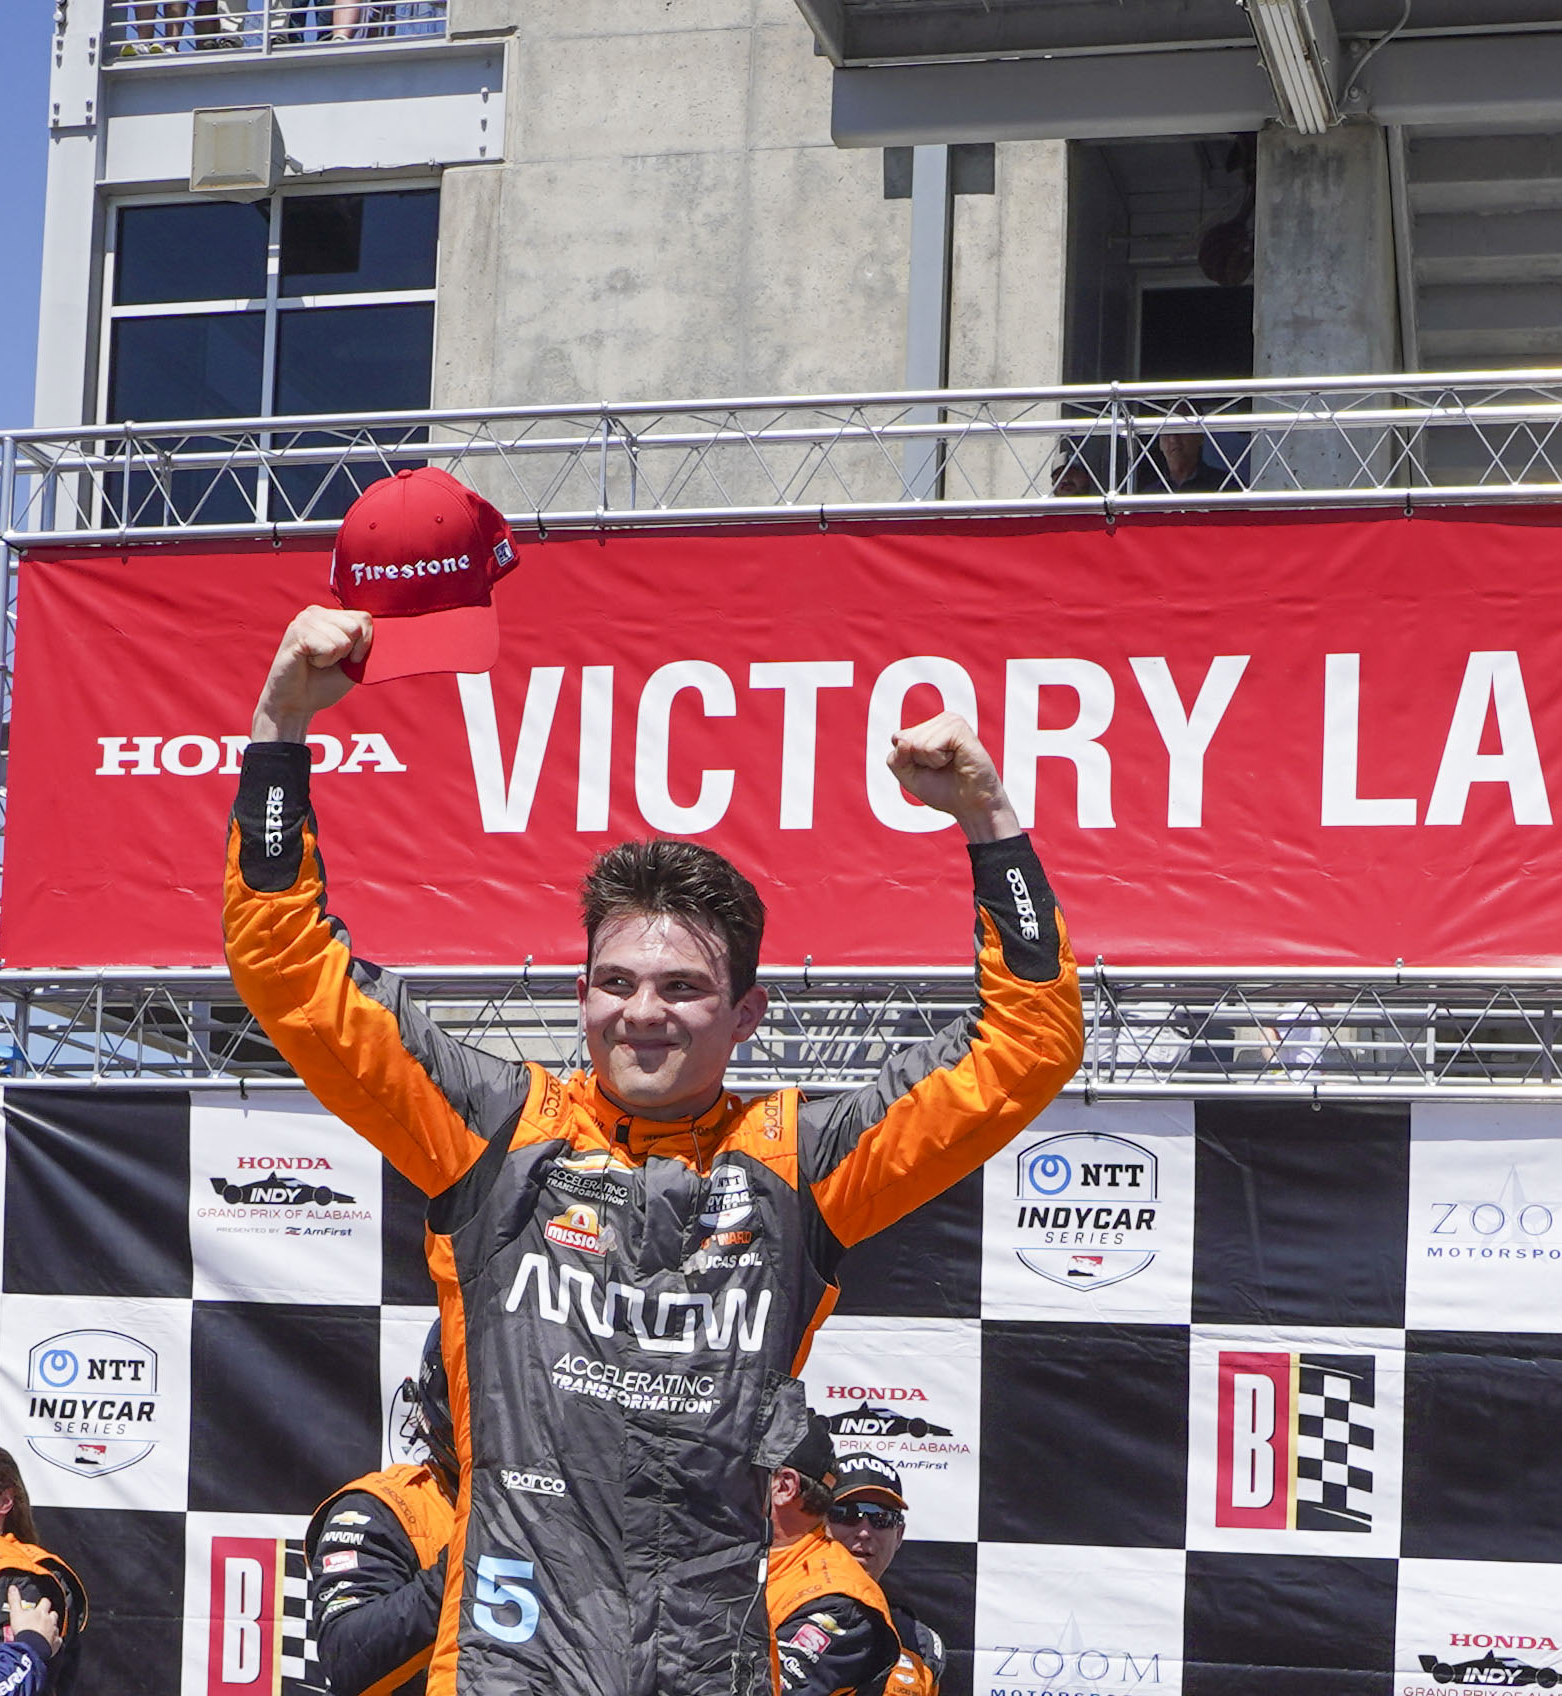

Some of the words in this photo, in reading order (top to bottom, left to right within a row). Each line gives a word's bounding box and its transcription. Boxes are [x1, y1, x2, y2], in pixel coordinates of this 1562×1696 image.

[350, 553, 470, 586] Firestone
[457, 655, 1250, 834] VICTORY
[266, 784, 285, 858] sparco
[1007, 868, 1040, 941] sparco
[237, 1157, 333, 1170] HONDA
[1081, 1164, 1144, 1187] NTT
[250, 1188, 302, 1203] INDY
[197, 1208, 246, 1218] GRAND
[250, 1208, 281, 1219] PRIX
[285, 1209, 302, 1220] OF
[306, 1210, 372, 1220] ALABAMA
[1017, 1206, 1156, 1230] INDYCAR
[303, 1227, 352, 1236] AmFirst
[1045, 1231, 1124, 1245] SERIES
[738, 1253, 763, 1267] OIL
[505, 1252, 772, 1353] ARROW
[87, 1359, 145, 1381] NTT
[553, 1352, 715, 1396] ACCELERATING
[552, 1371, 714, 1414] TRANSFORMATION
[826, 1386, 929, 1401] HONDA
[29, 1398, 155, 1422] INDYCAR
[54, 1421, 126, 1435] SERIES
[839, 1418, 895, 1434] INDY
[839, 1440, 873, 1451] PRIX
[876, 1441, 896, 1451] OF
[900, 1442, 971, 1454] ALABAMA
[896, 1460, 949, 1470] AmFirst
[500, 1468, 567, 1497] sparco
[472, 1554, 540, 1643] 5
[1449, 1633, 1559, 1650] HONDA
[991, 1646, 1165, 1684] ZOOM
[1463, 1667, 1523, 1684] INDY
